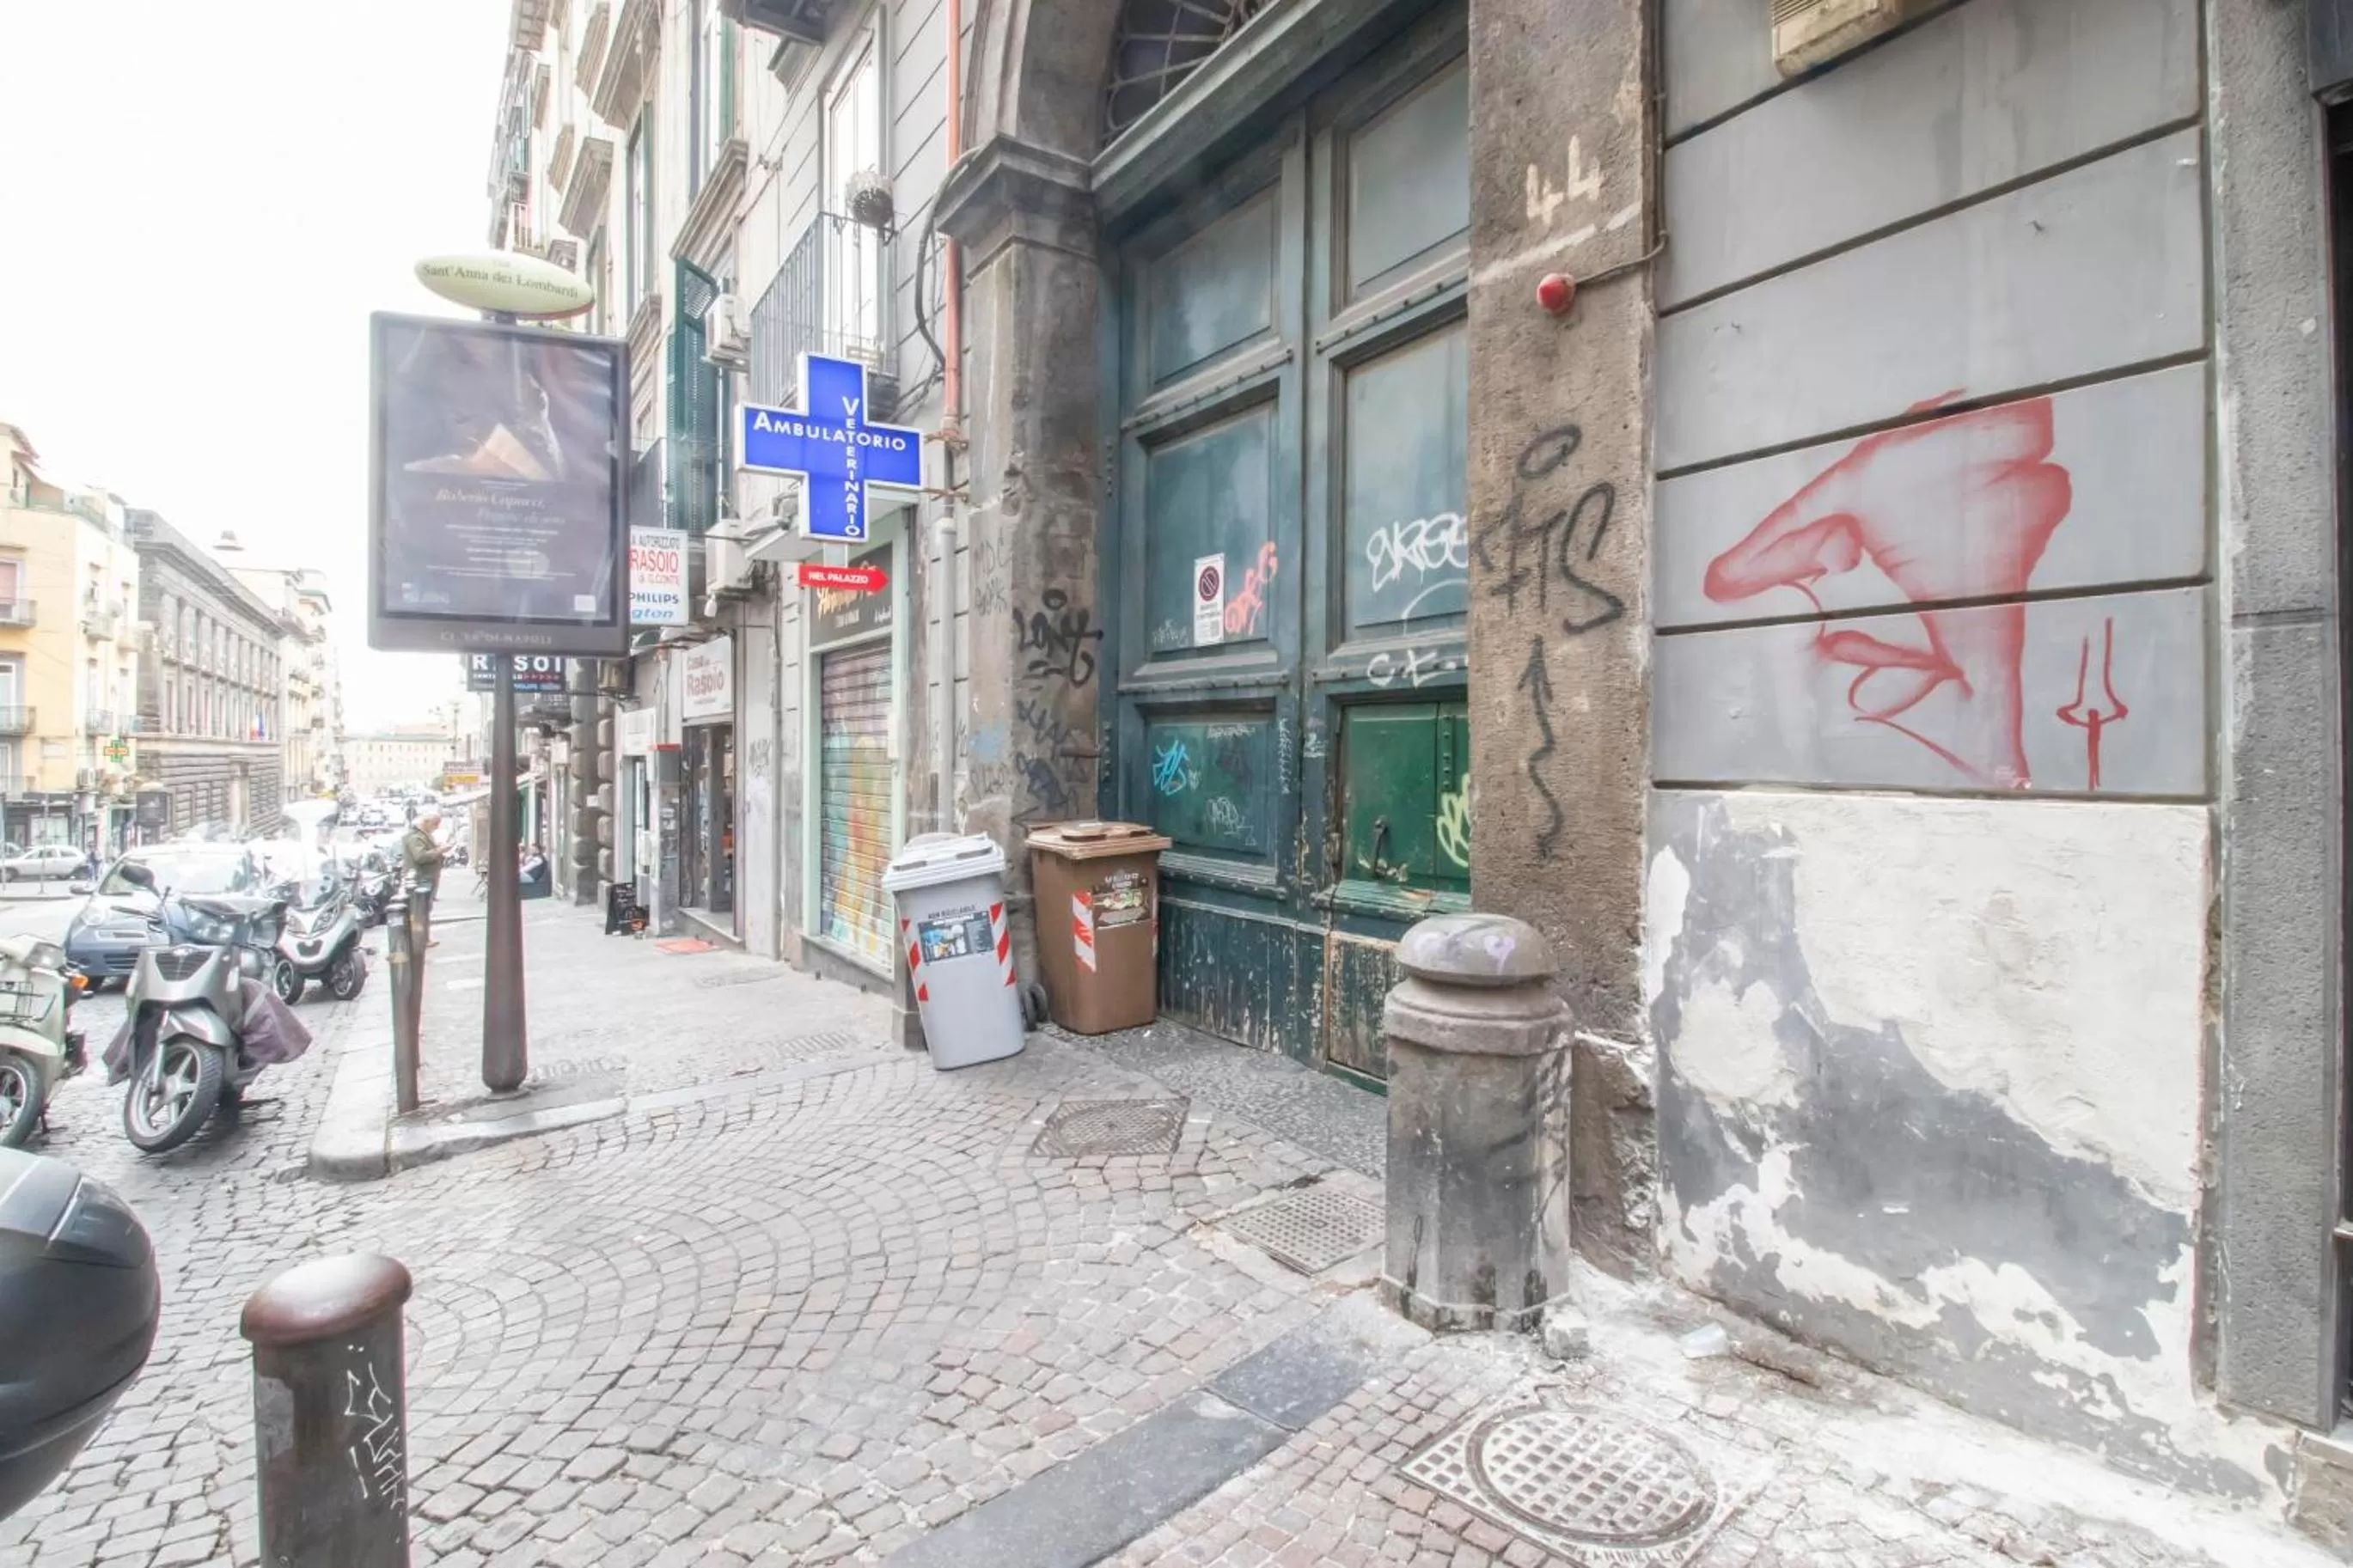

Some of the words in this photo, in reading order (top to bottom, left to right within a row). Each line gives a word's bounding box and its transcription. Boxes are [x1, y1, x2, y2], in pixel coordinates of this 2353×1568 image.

[423, 264, 488, 281] Sant'Anna
[492, 271, 512, 284] dei
[516, 274, 578, 298] Lombardi
[754, 412, 906, 451] AMBULATORIO
[842, 396, 860, 536] VETERINARIO
[629, 546, 679, 573] RASOIO
[828, 573, 869, 584] PALAZZO
[629, 592, 679, 605] PHILIPS
[474, 655, 562, 673] RSOI
